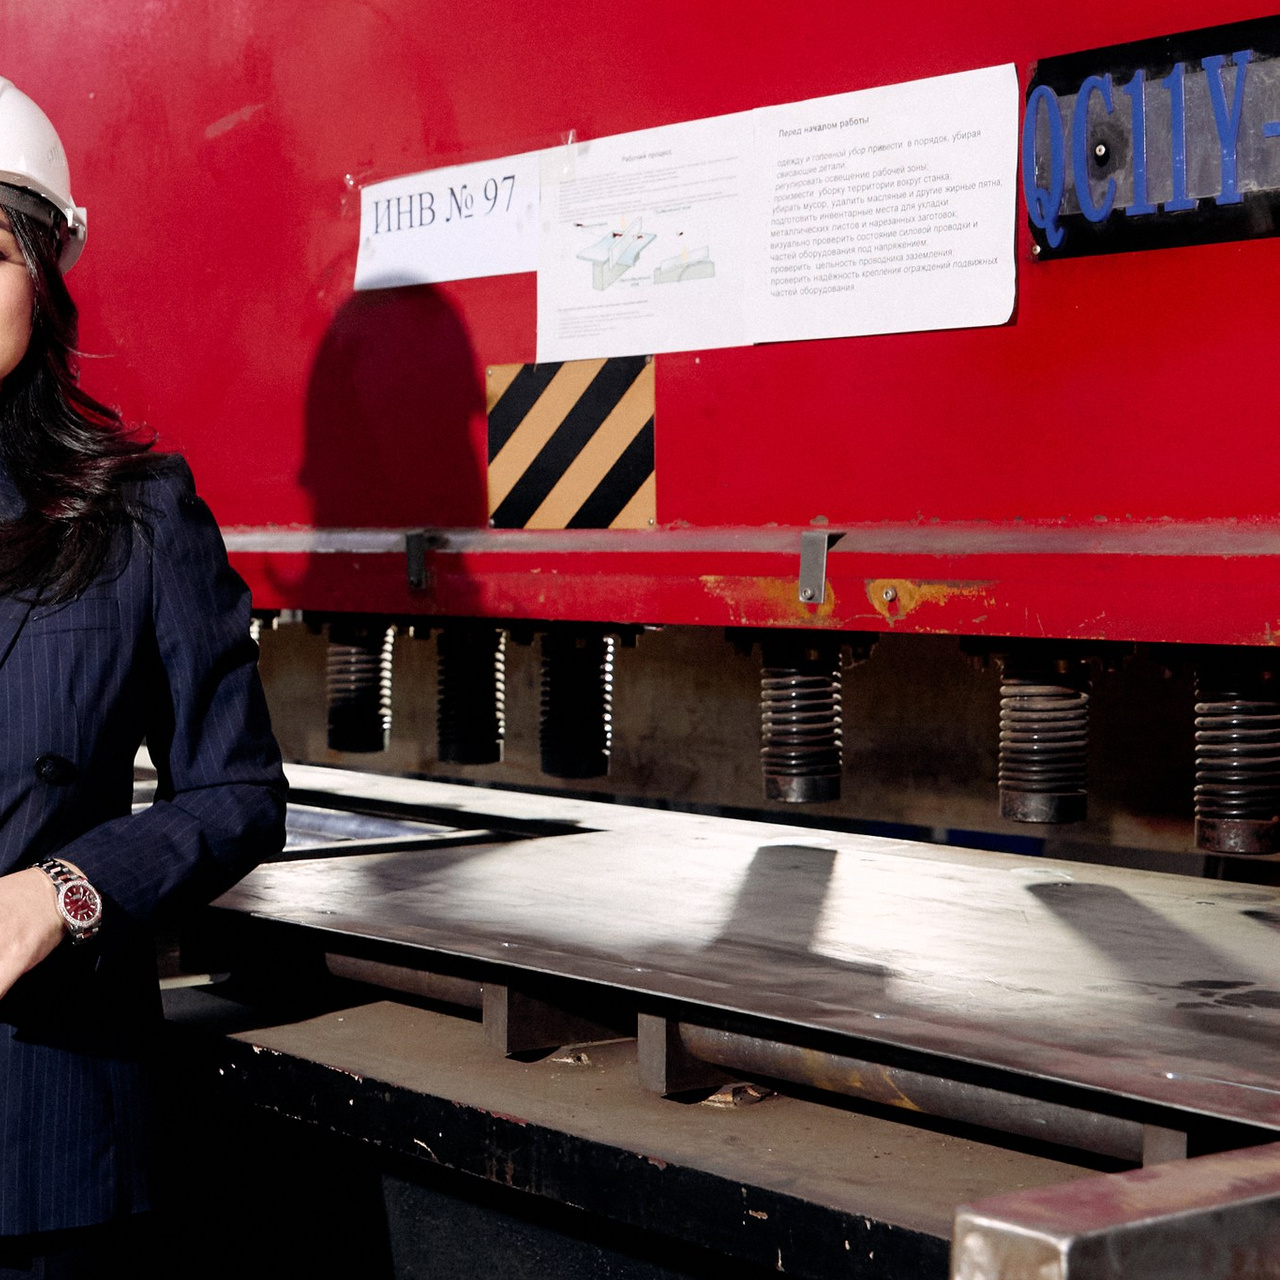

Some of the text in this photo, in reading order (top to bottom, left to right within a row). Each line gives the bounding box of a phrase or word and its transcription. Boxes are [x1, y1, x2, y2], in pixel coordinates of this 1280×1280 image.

[779, 117, 869, 138] Перед началом работы
[777, 157, 803, 167] одежду
[812, 149, 846, 161] головной
[848, 147, 866, 158] убор
[868, 142, 902, 154] привести
[952, 130, 981, 143] убирая
[775, 177, 822, 192] регулировать
[825, 171, 870, 183] освещение
[873, 165, 905, 178] рабочей
[776, 167, 817, 179] свисающие
[772, 203, 801, 216] убирать
[831, 198, 864, 208] удалить
[867, 191, 906, 202] масляные
[916, 186, 942, 198] другие
[945, 182, 976, 193] жирные
[774, 191, 814, 202] произвести
[818, 187, 845, 198] уборку
[848, 181, 894, 194] территории
[897, 177, 921, 190] вокруг
[374, 192, 435, 234] ИНВ
[446, 184, 474, 222] №
[484, 175, 515, 215] 97
[771, 199, 949, 225] подготовить инвентарные места для укладки
[770, 239, 810, 250] визуально
[812, 235, 854, 246] проверить
[856, 228, 897, 241] состояние
[899, 224, 931, 236] силовой
[934, 222, 970, 234] проводки
[771, 225, 829, 237] металлических
[832, 222, 859, 231] листов
[869, 214, 915, 227] нарезанных
[770, 252, 796, 261] частей
[799, 247, 855, 259] оборудования
[770, 264, 811, 274] проверить
[815, 259, 856, 270] цельность
[859, 254, 903, 266] проводника
[770, 257, 998, 286] проверить надёжность крепления ограждений подвижных
[771, 288, 798, 297] частей
